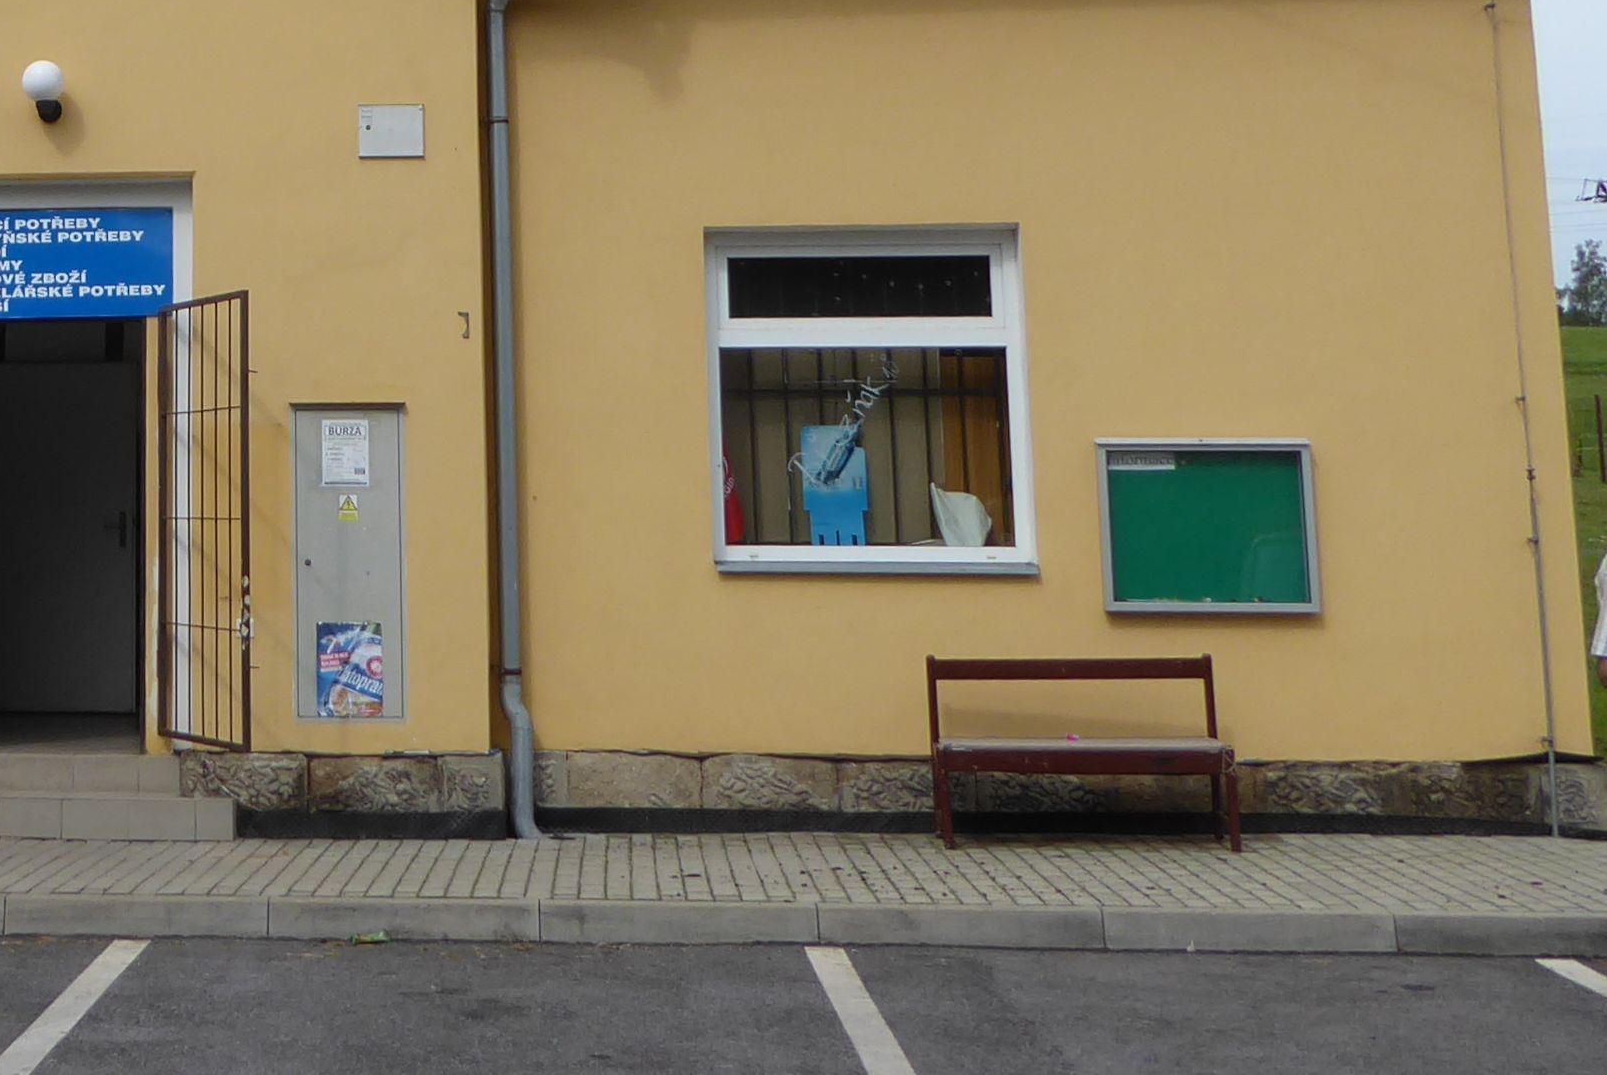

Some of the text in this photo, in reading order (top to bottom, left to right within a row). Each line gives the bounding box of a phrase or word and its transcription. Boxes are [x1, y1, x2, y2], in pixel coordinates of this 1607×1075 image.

[15, 217, 101, 230] POTŘEBY
[57, 230, 144, 243] POTŘEBY
[31, 270, 87, 285] ZBOŽÍ
[79, 283, 166, 297] POTŘEBY
